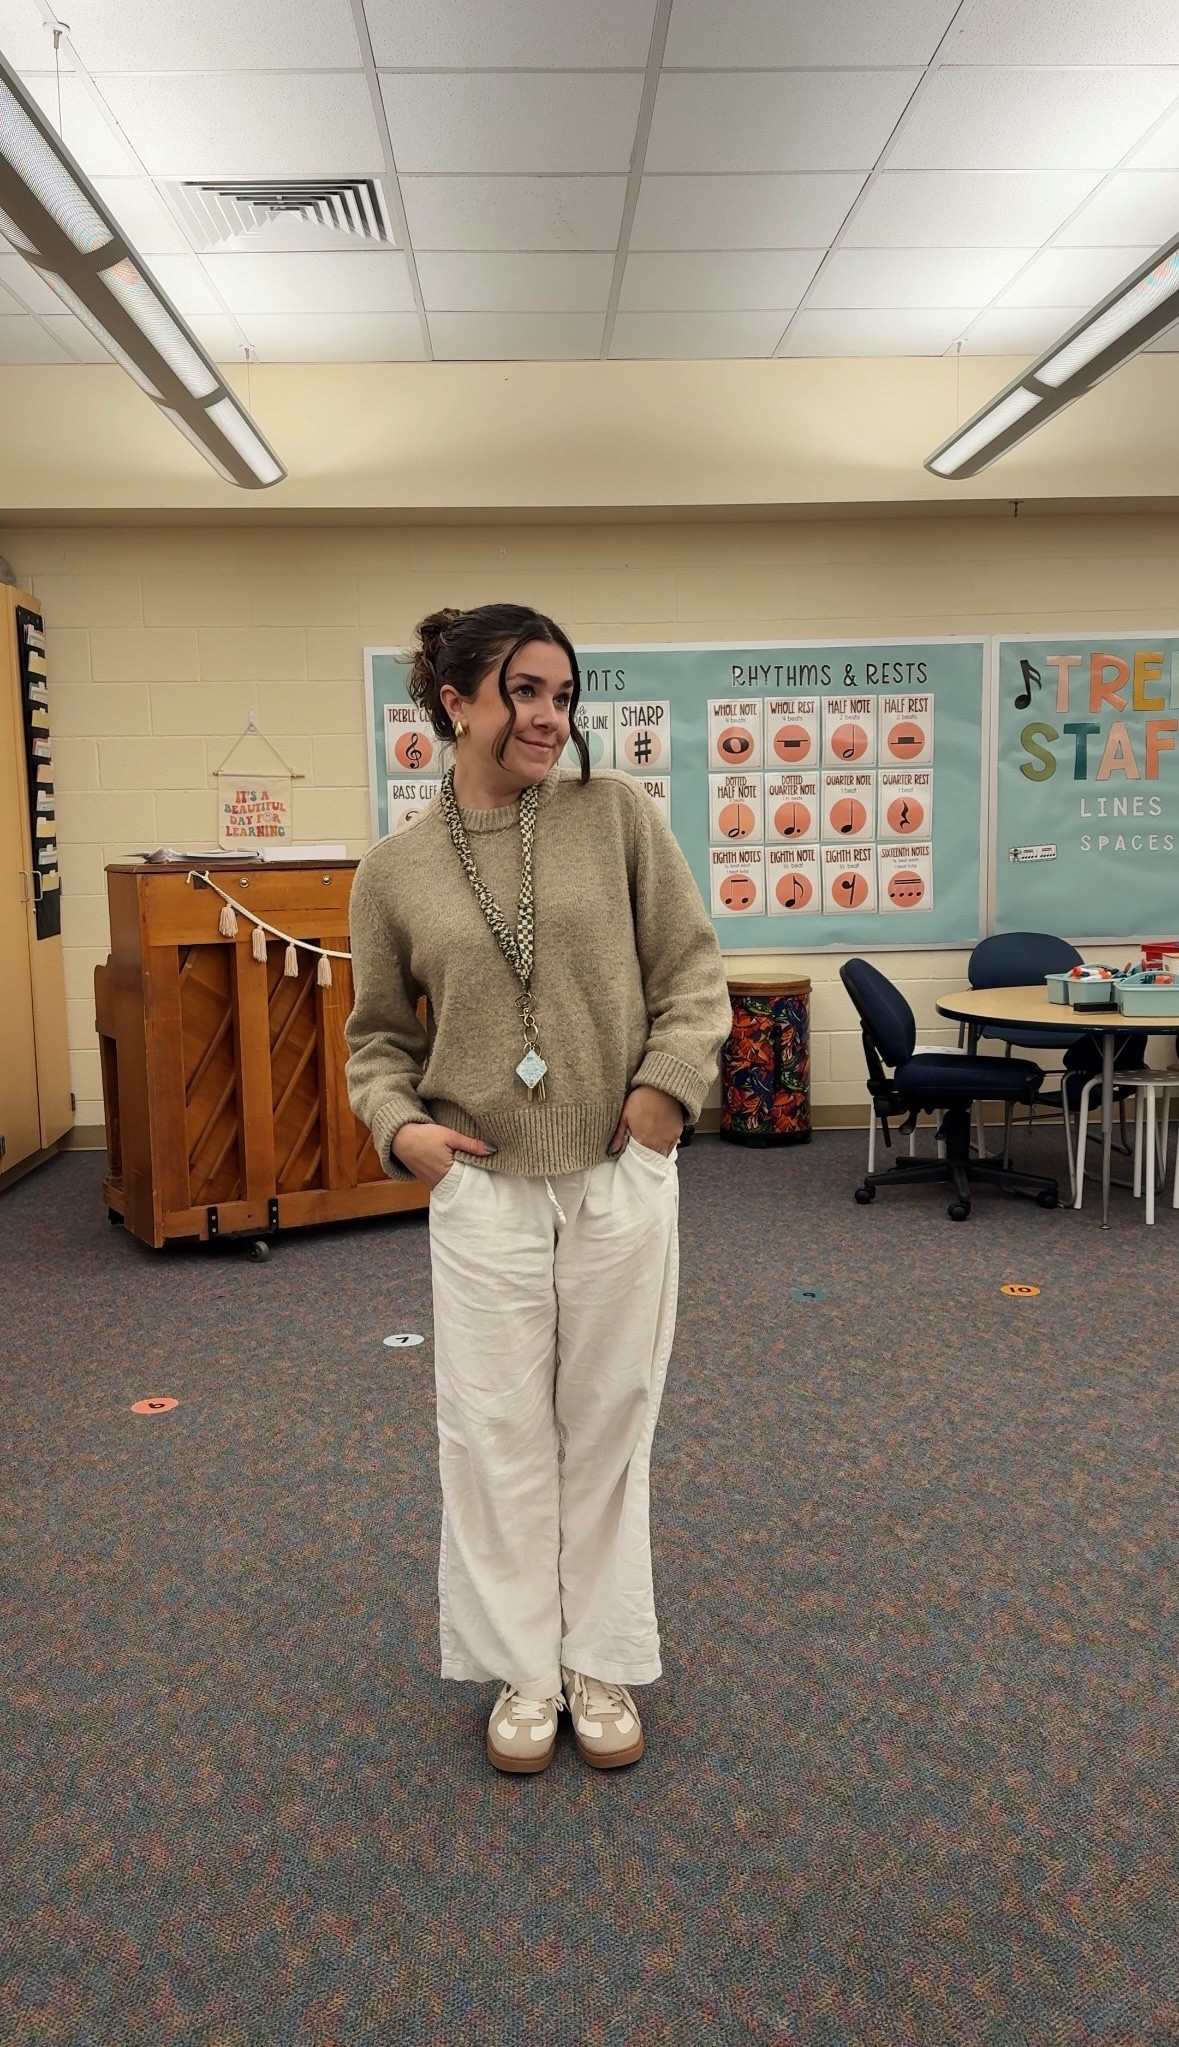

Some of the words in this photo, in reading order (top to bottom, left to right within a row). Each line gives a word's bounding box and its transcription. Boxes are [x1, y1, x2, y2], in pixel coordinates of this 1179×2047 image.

[579, 670, 626, 692] NTS
[732, 664, 832, 688] RHYTHMS
[843, 664, 858, 687] &
[866, 662, 928, 685] RESTS
[714, 704, 737, 716] WHOLE
[740, 703, 757, 716] NOTE
[770, 701, 795, 714] WHOLE
[798, 701, 815, 714] REST
[828, 700, 847, 714] HALF
[850, 700, 871, 713] NOTE
[884, 698, 905, 713] HALF
[908, 698, 929, 712] REST
[388, 709, 416, 722] TREBLE
[420, 709, 431, 722] CL
[620, 706, 664, 726] SHARP
[592, 716, 608, 729] LINE
[1020, 719, 1178, 782] STAF
[726, 776, 747, 786] DOTTED
[781, 775, 803, 785] DOTTED
[826, 775, 854, 786] QUARTER
[856, 775, 871, 785] NOTE
[883, 774, 912, 785] QUARTER
[914, 774, 929, 785] REST
[236, 790, 257, 803] IT'S
[261, 791, 270, 800] A
[393, 785, 416, 800] BASS
[717, 786, 735, 799] HALF
[738, 786, 757, 798] NOTE
[769, 785, 798, 796] QUARTER
[800, 784, 816, 795] NOTE
[224, 802, 286, 814] BEAUTIFUL
[1080, 796, 1162, 817] LINES
[230, 816, 253, 825] DAY
[226, 825, 285, 837] LEARNING
[1080, 835, 1174, 851] SPACES
[713, 852, 736, 864] EIGHTH
[739, 851, 761, 863] NOTES
[770, 851, 794, 864] EIGHTH
[797, 850, 815, 862] NOTE
[826, 850, 851, 863] EIGHTH
[854, 848, 872, 862] REST
[882, 848, 909, 858] SIXTEENTH
[911, 846, 929, 856] NOTES
